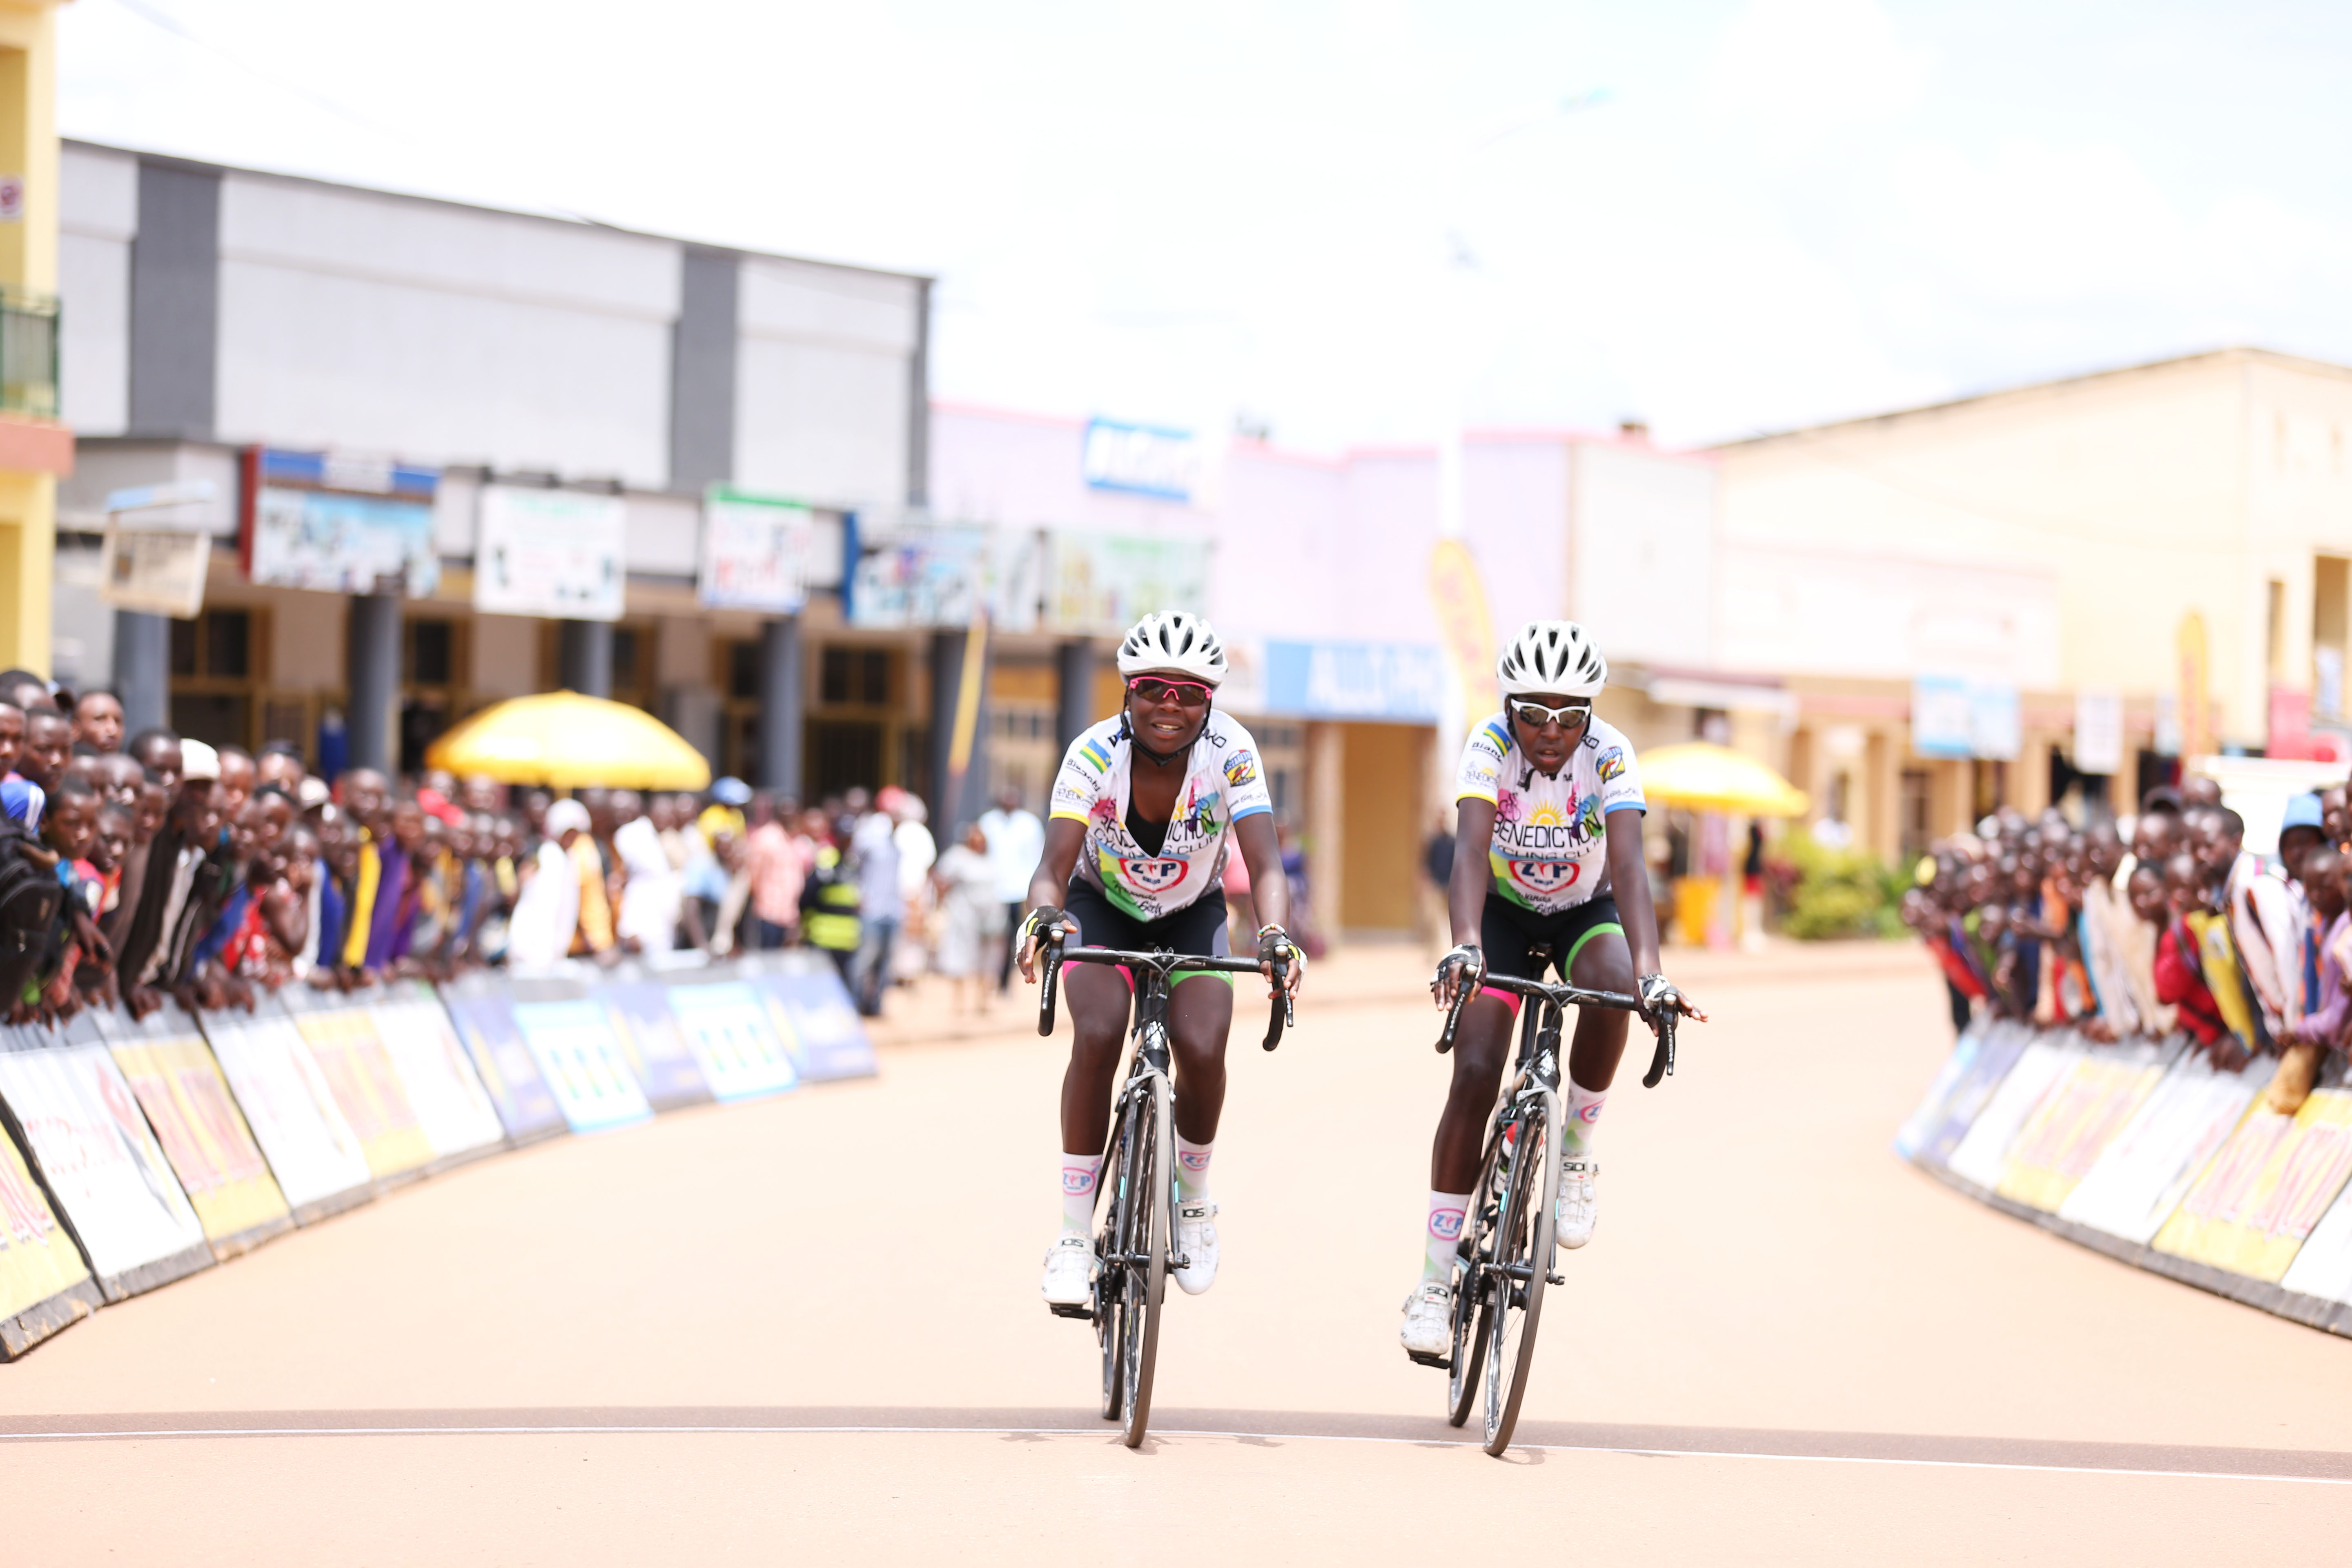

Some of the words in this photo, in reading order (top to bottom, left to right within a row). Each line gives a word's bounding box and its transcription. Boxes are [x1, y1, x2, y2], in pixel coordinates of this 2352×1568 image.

[1494, 811, 1602, 848] BENEDICTION
[1043, 960, 1055, 998] ULTEGRA
[1449, 993, 1465, 1029] ULTEGRA
